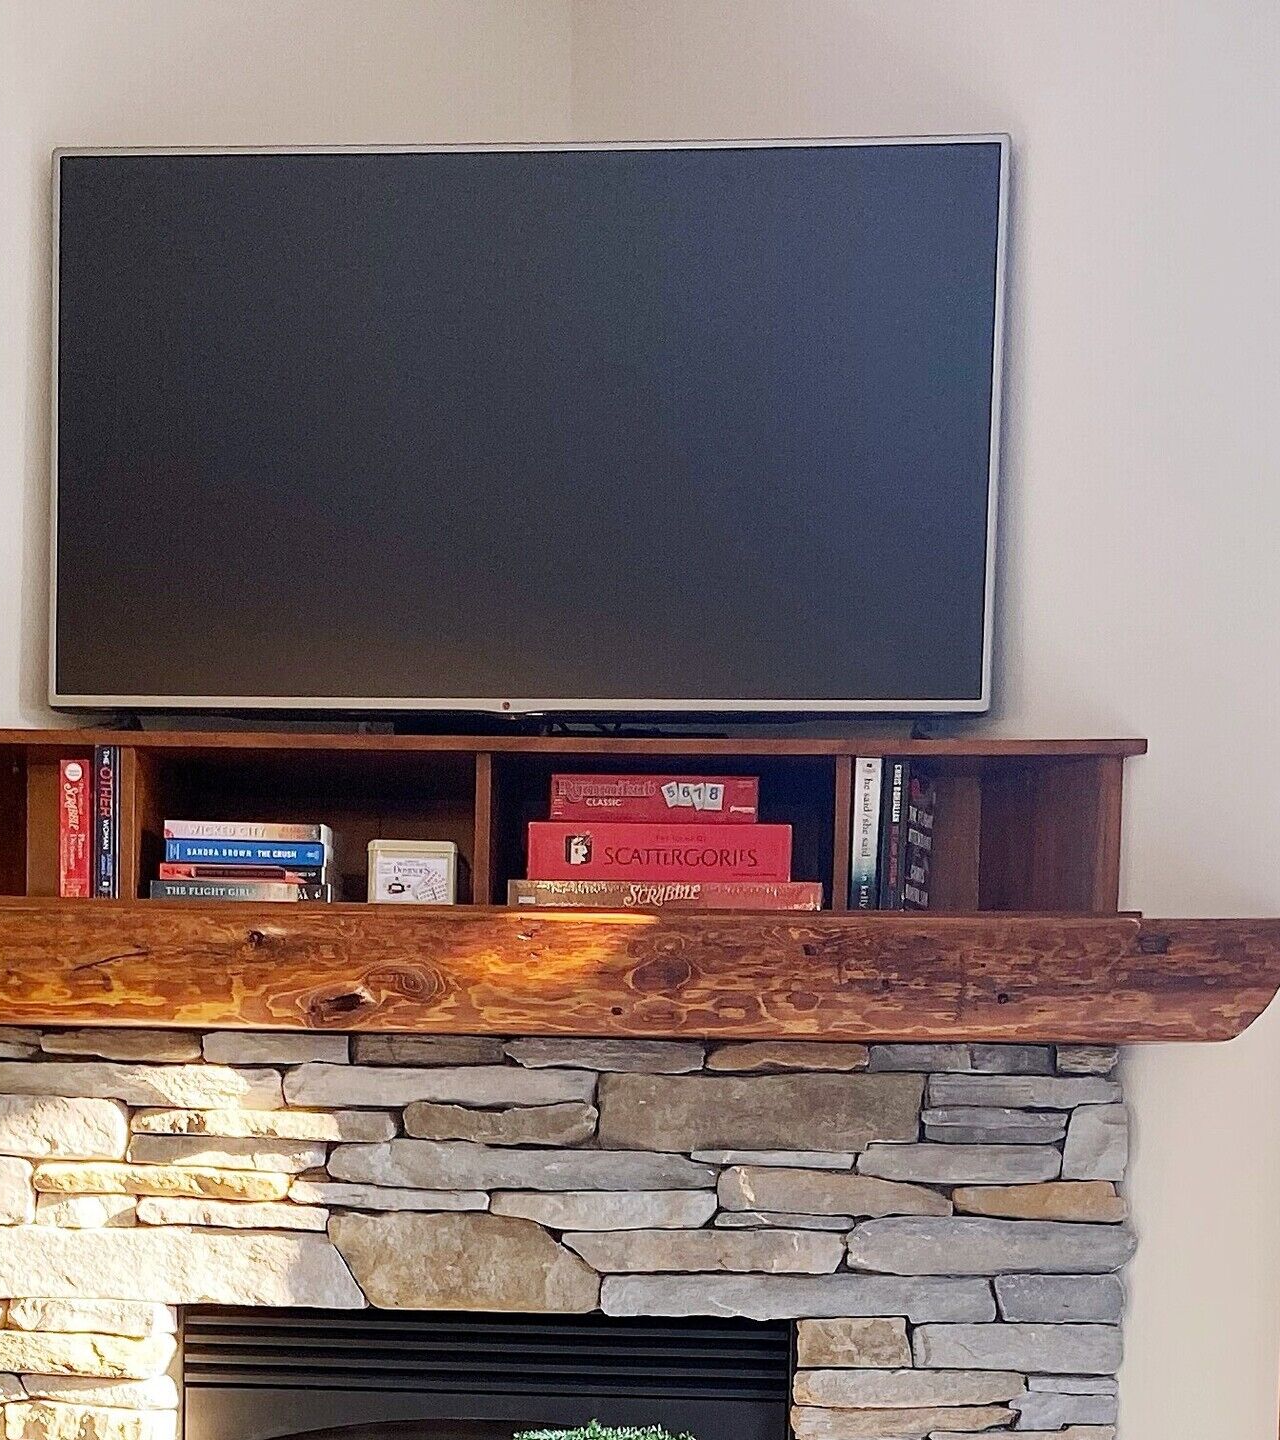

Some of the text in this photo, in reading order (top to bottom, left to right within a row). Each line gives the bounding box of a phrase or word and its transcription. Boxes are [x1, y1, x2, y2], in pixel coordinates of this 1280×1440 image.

[102, 750, 110, 765] THE
[100, 766, 113, 817] OTHER
[708, 786, 718, 800] 8
[585, 798, 622, 807] CLASSIC
[102, 820, 110, 850] WOMAN
[189, 825, 266, 837] WICKED CITY
[186, 848, 219, 857] SANDRA
[222, 849, 252, 858] BROWN
[257, 850, 271, 858] THE
[272, 850, 297, 859] CRUSH
[604, 847, 759, 868] SCATTERGORIES
[165, 886, 187, 896] THE
[189, 886, 226, 897] FLIGHT
[623, 883, 701, 907] SCRABBLE
